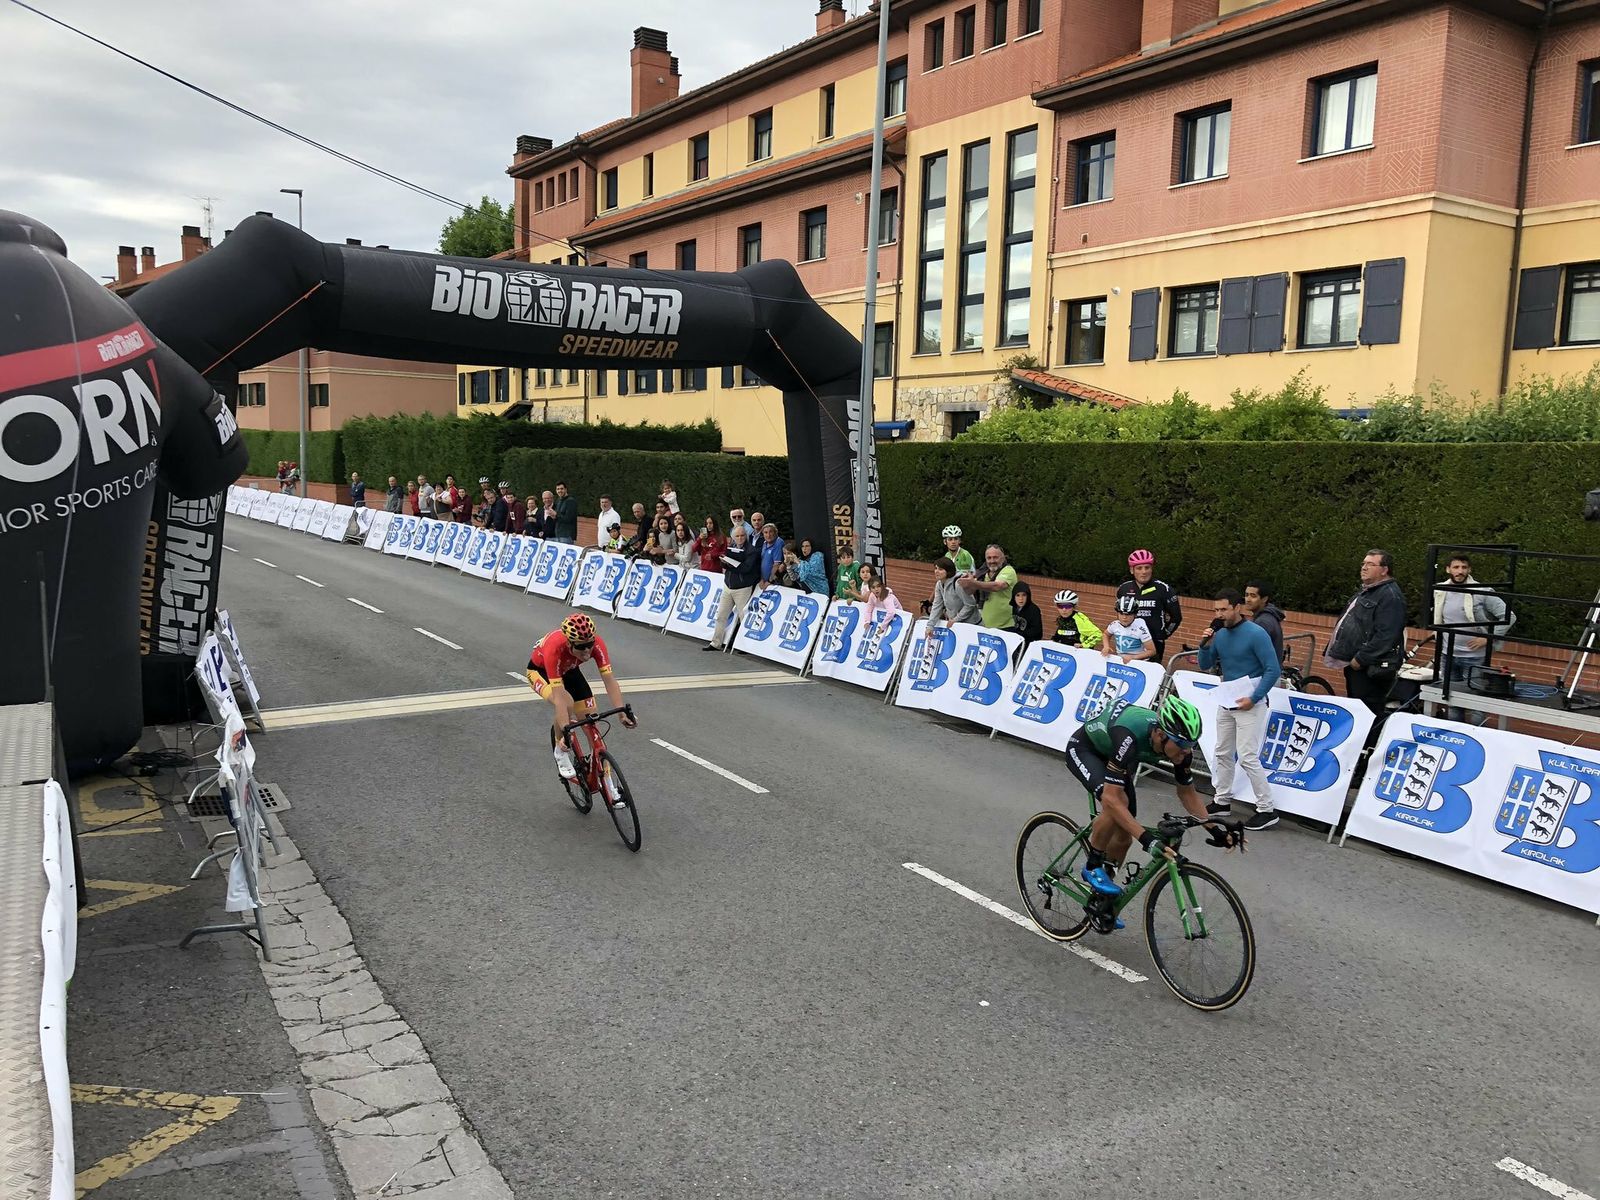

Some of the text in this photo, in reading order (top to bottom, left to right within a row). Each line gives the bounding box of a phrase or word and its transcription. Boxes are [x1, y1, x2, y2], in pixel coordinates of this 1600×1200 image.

[566, 281, 683, 336] RACER
[558, 333, 679, 359] SPEEDWEAR
[54, 476, 131, 517] SPORTS
[158, 525, 214, 657] RACER
[1136, 599, 1156, 608] BIKE
[1109, 667, 1138, 678] KULTURA
[1296, 703, 1338, 716] KULTURA
[1417, 729, 1466, 746] KULTURA
[1547, 758, 1600, 776] KULTURA
[1273, 776, 1306, 787] KIROLAK
[1395, 811, 1436, 828] KIROLAK
[1520, 847, 1566, 867] KIROLAK
